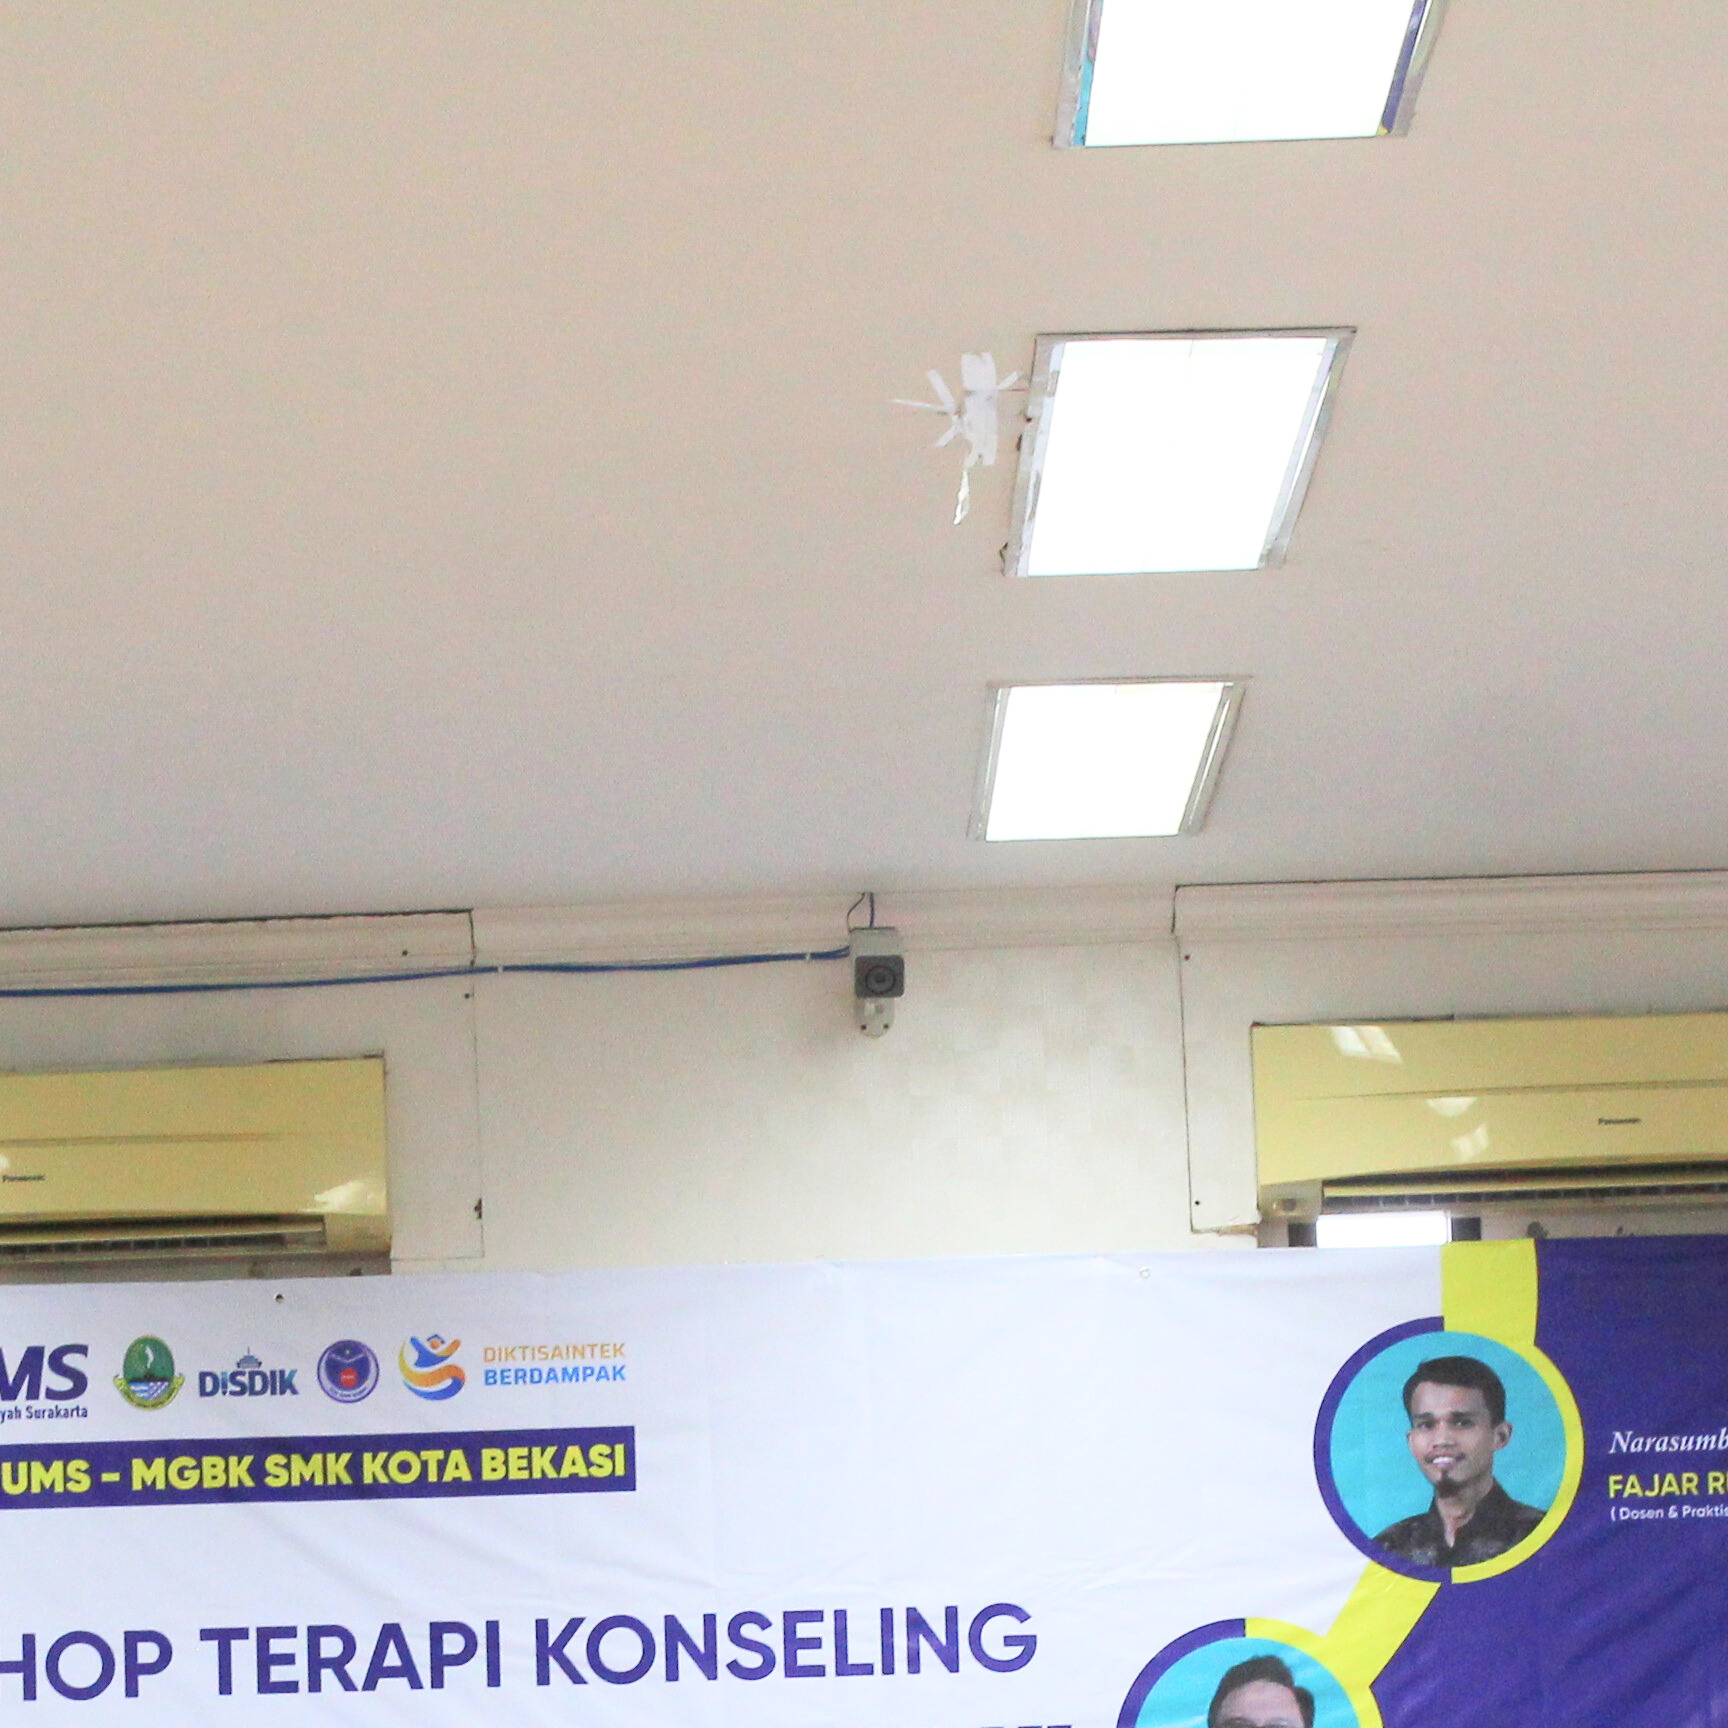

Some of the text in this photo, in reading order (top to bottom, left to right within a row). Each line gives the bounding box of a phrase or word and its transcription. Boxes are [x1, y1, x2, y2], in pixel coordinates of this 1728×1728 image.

[483, 1343, 626, 1363] DIKTISAINTEK
[484, 1365, 626, 1386] BERDAMPAK
[26, 1406, 88, 1419] Surakarta
[1, 1459, 91, 1495] UMS
[131, 1453, 255, 1490] MGBK
[264, 1451, 352, 1487] SMK
[362, 1449, 470, 1485] KOTA
[481, 1443, 626, 1481] BEKASI
[1609, 1473, 1700, 1498] FAJAR
[1620, 1506, 1664, 1520] Dosen
[1669, 1505, 1678, 1519] &
[200, 1620, 501, 1696] TERAPI
[536, 1602, 1038, 1687] KONSELING
